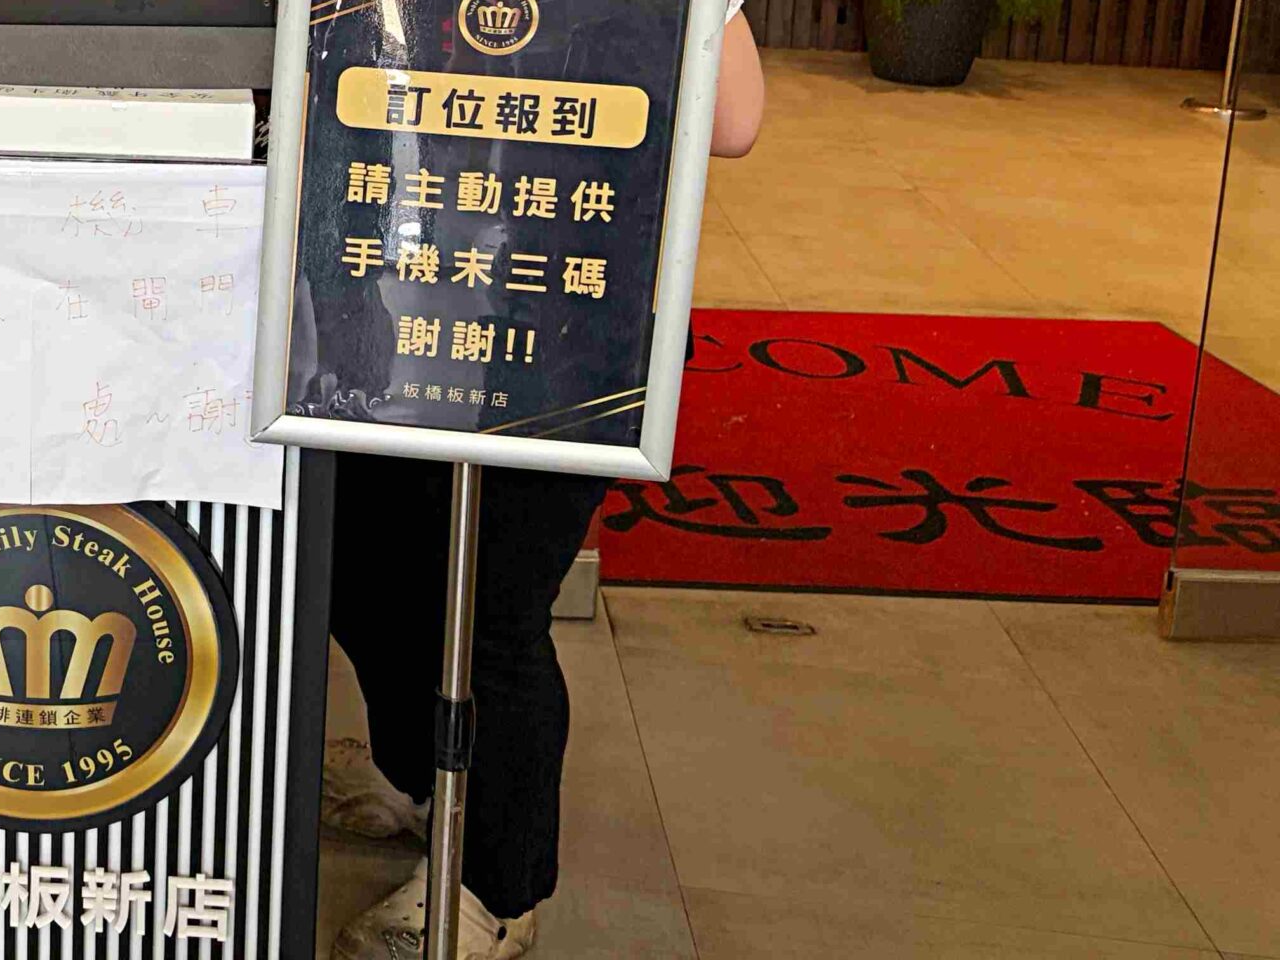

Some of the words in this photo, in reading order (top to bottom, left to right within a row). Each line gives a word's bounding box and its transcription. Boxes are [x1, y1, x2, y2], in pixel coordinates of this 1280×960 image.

[386, 86, 598, 140] 訂位報到
[347, 162, 616, 223] 請主動提供
[341, 237, 608, 299] 手機末三碼
[397, 316, 537, 364] 謝謝!!
[402, 382, 510, 409] 板橋板新店
[685, 318, 1175, 422] COME
[52, 524, 133, 579] Steak
[132, 577, 175, 666] House
[62, 737, 134, 784] 1995
